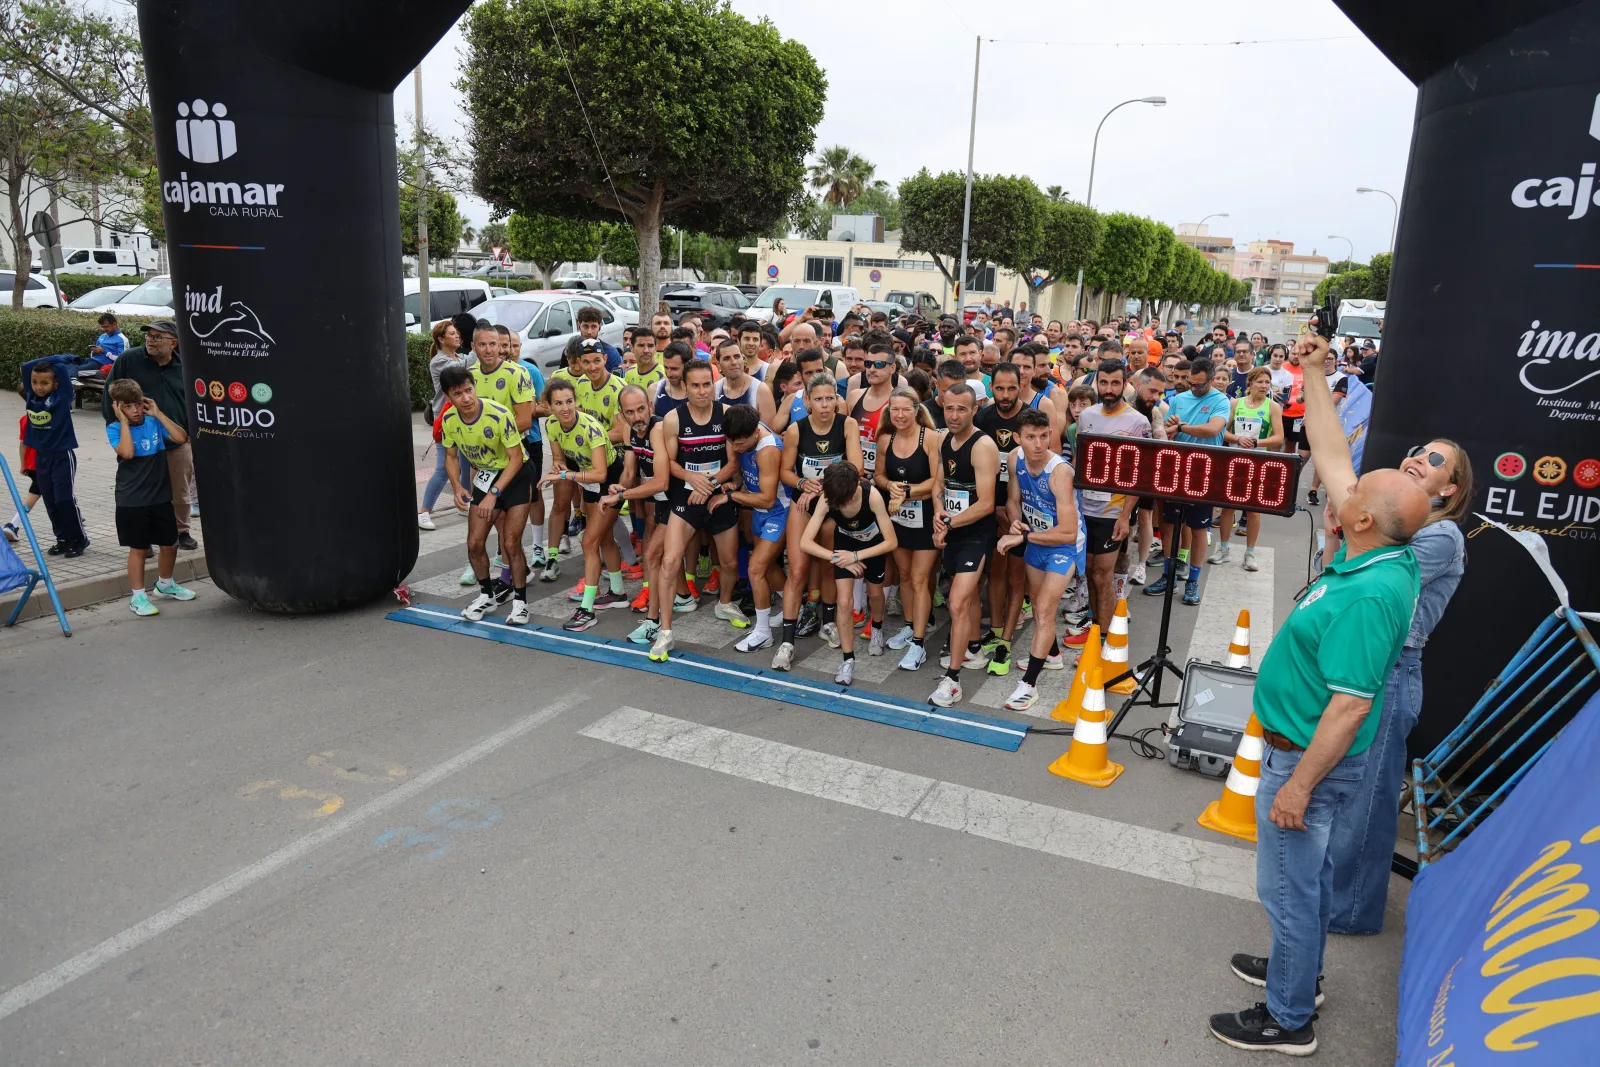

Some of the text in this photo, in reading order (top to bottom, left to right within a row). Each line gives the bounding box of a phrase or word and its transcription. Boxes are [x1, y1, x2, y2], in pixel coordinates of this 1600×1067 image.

[163, 171, 285, 213] cajamar
[1511, 163, 1600, 220] caj
[209, 206, 284, 218] CAJA RURAL
[185, 284, 223, 314] imd
[207, 348, 231, 356] Deportes
[224, 341, 257, 351] Municipal
[1536, 397, 1582, 409] Instituto
[196, 402, 275, 428] EL EJIDO
[1548, 408, 1597, 421] Deportes
[1241, 423, 1252, 431] 11
[236, 431, 275, 439] QUALITY
[687, 463, 700, 472] XIII
[805, 459, 819, 467] XIII
[945, 498, 962, 512] 104
[1485, 486, 1524, 517] EL
[1023, 503, 1034, 514] XIII
[1028, 515, 1049, 530] 105
